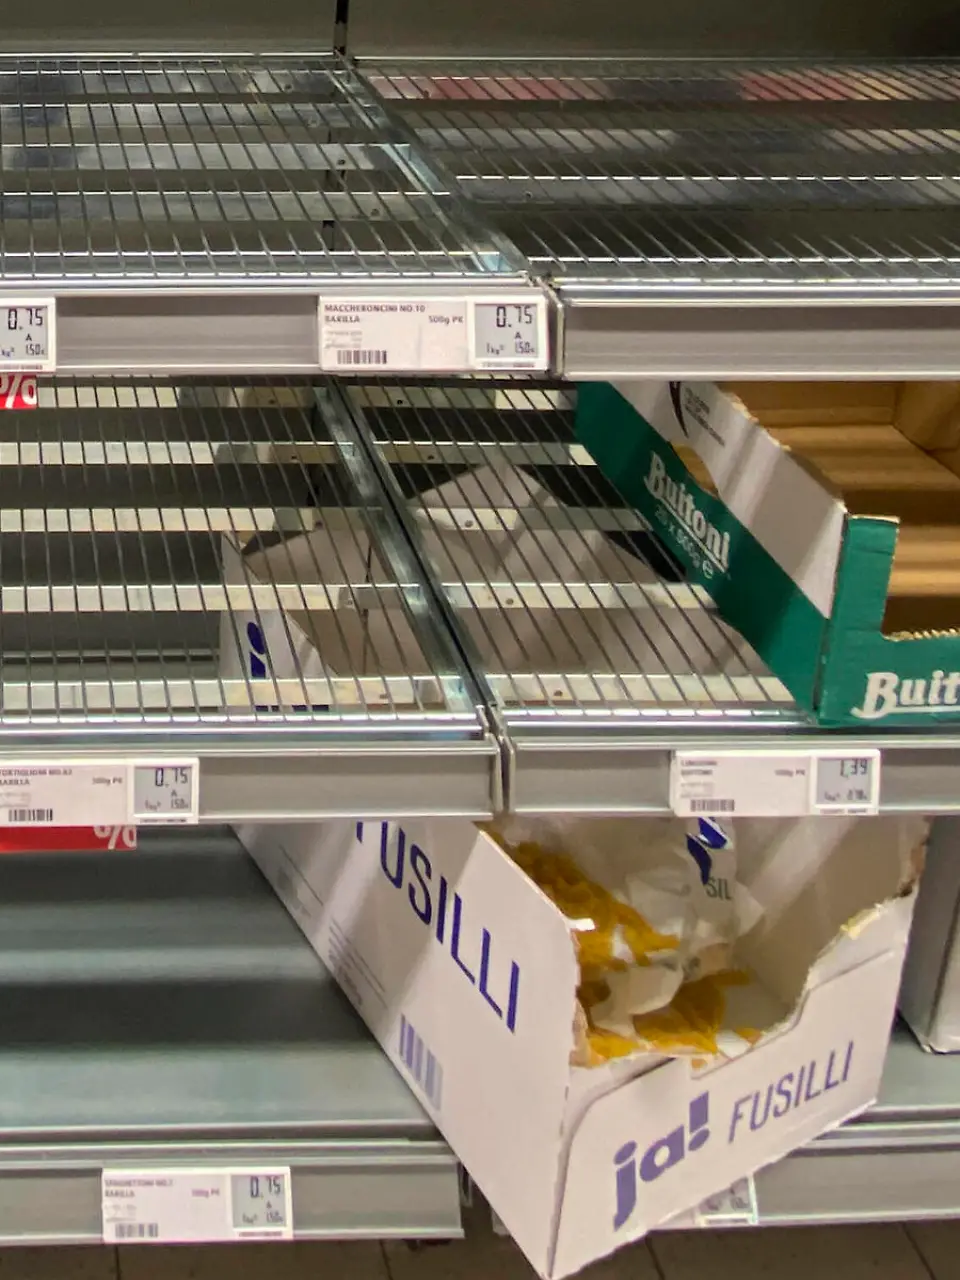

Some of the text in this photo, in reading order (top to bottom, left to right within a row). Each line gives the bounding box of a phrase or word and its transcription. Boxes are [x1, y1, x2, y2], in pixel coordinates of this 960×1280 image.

[8, 308, 43, 330] 0.75
[324, 304, 398, 313] MACCHERONCINI
[496, 306, 533, 328] 0.75
[428, 315, 450, 325] 500g
[643, 450, 731, 573] Buitoni
[155, 767, 188, 787] 0.75
[356, 821, 520, 1034] USILLI
[728, 1040, 854, 1145] FUSILLI
[613, 1090, 710, 1232] ja!
[250, 1176, 281, 1199] 0.75
